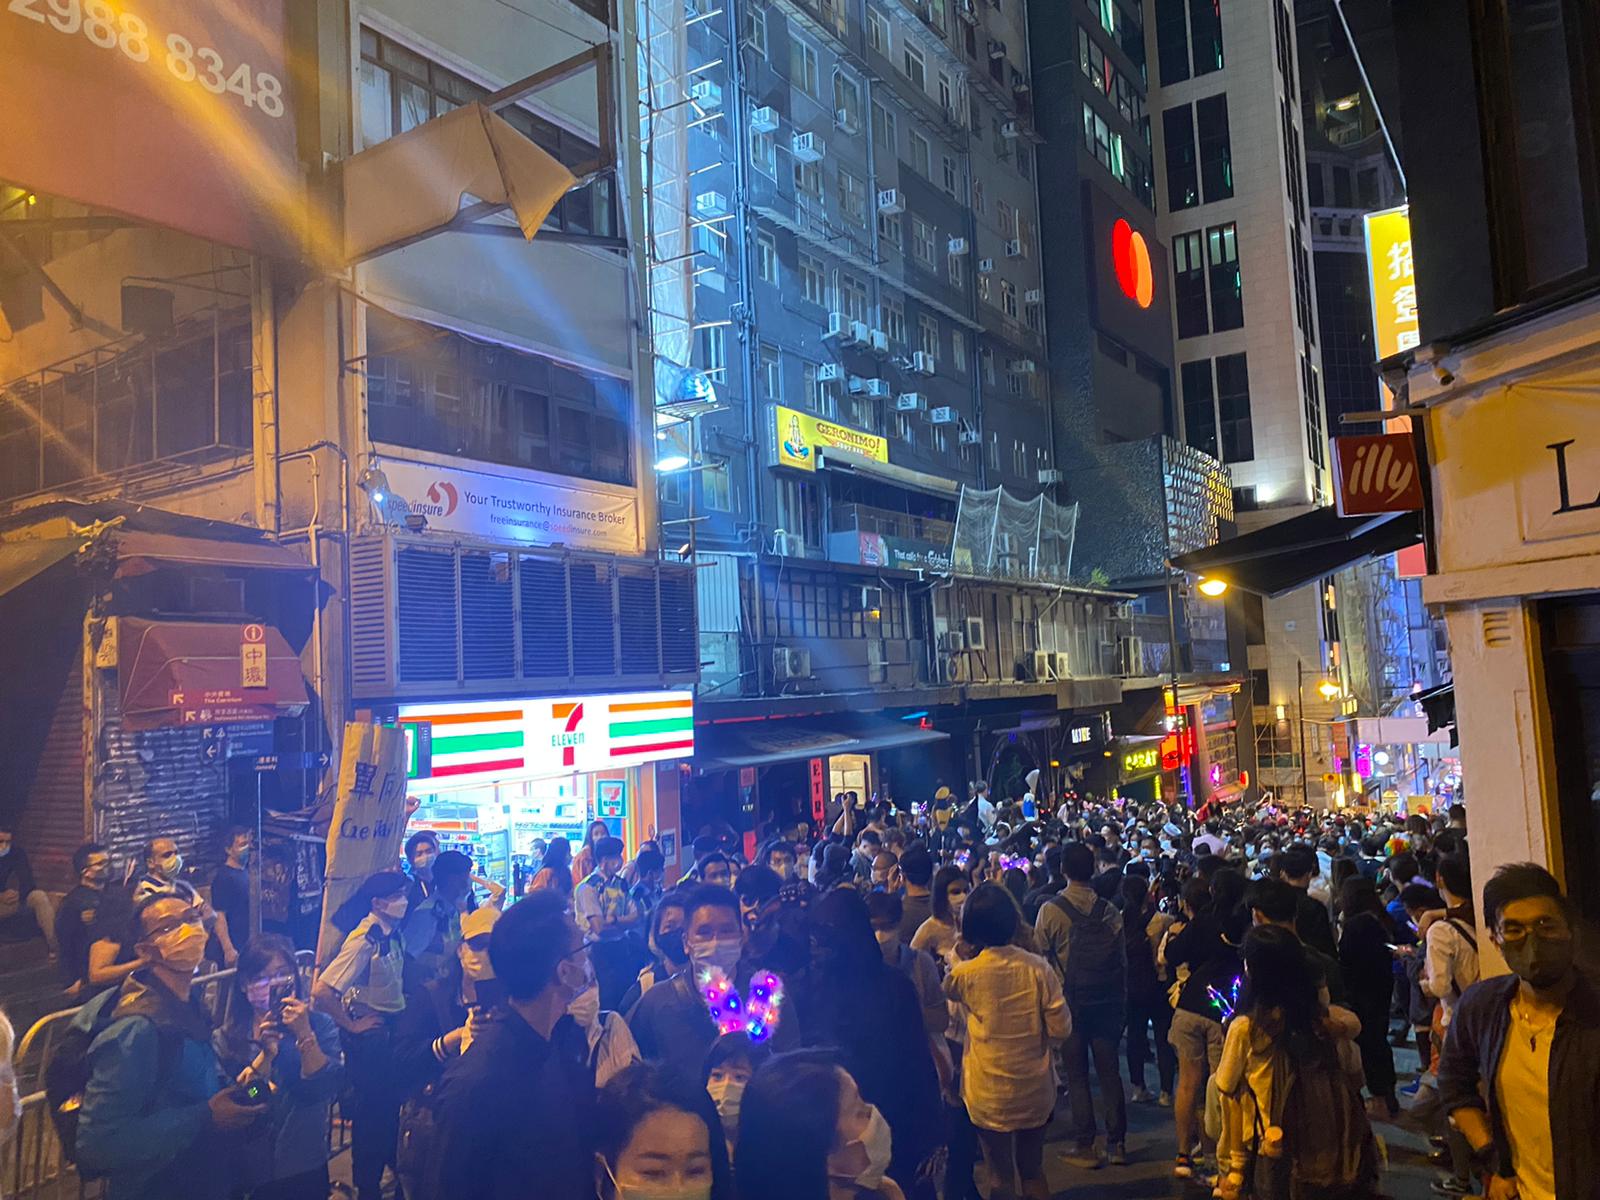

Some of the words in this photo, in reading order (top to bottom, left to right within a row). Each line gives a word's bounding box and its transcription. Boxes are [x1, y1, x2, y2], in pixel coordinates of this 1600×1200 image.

[165, 33, 285, 118] 8348
[816, 422, 880, 453] GERONIMO!
[1349, 443, 1413, 503] illy
[464, 491, 488, 506] Your
[490, 495, 551, 516] Trustworthy
[553, 503, 597, 522] Insurance
[598, 510, 626, 526] Broker
